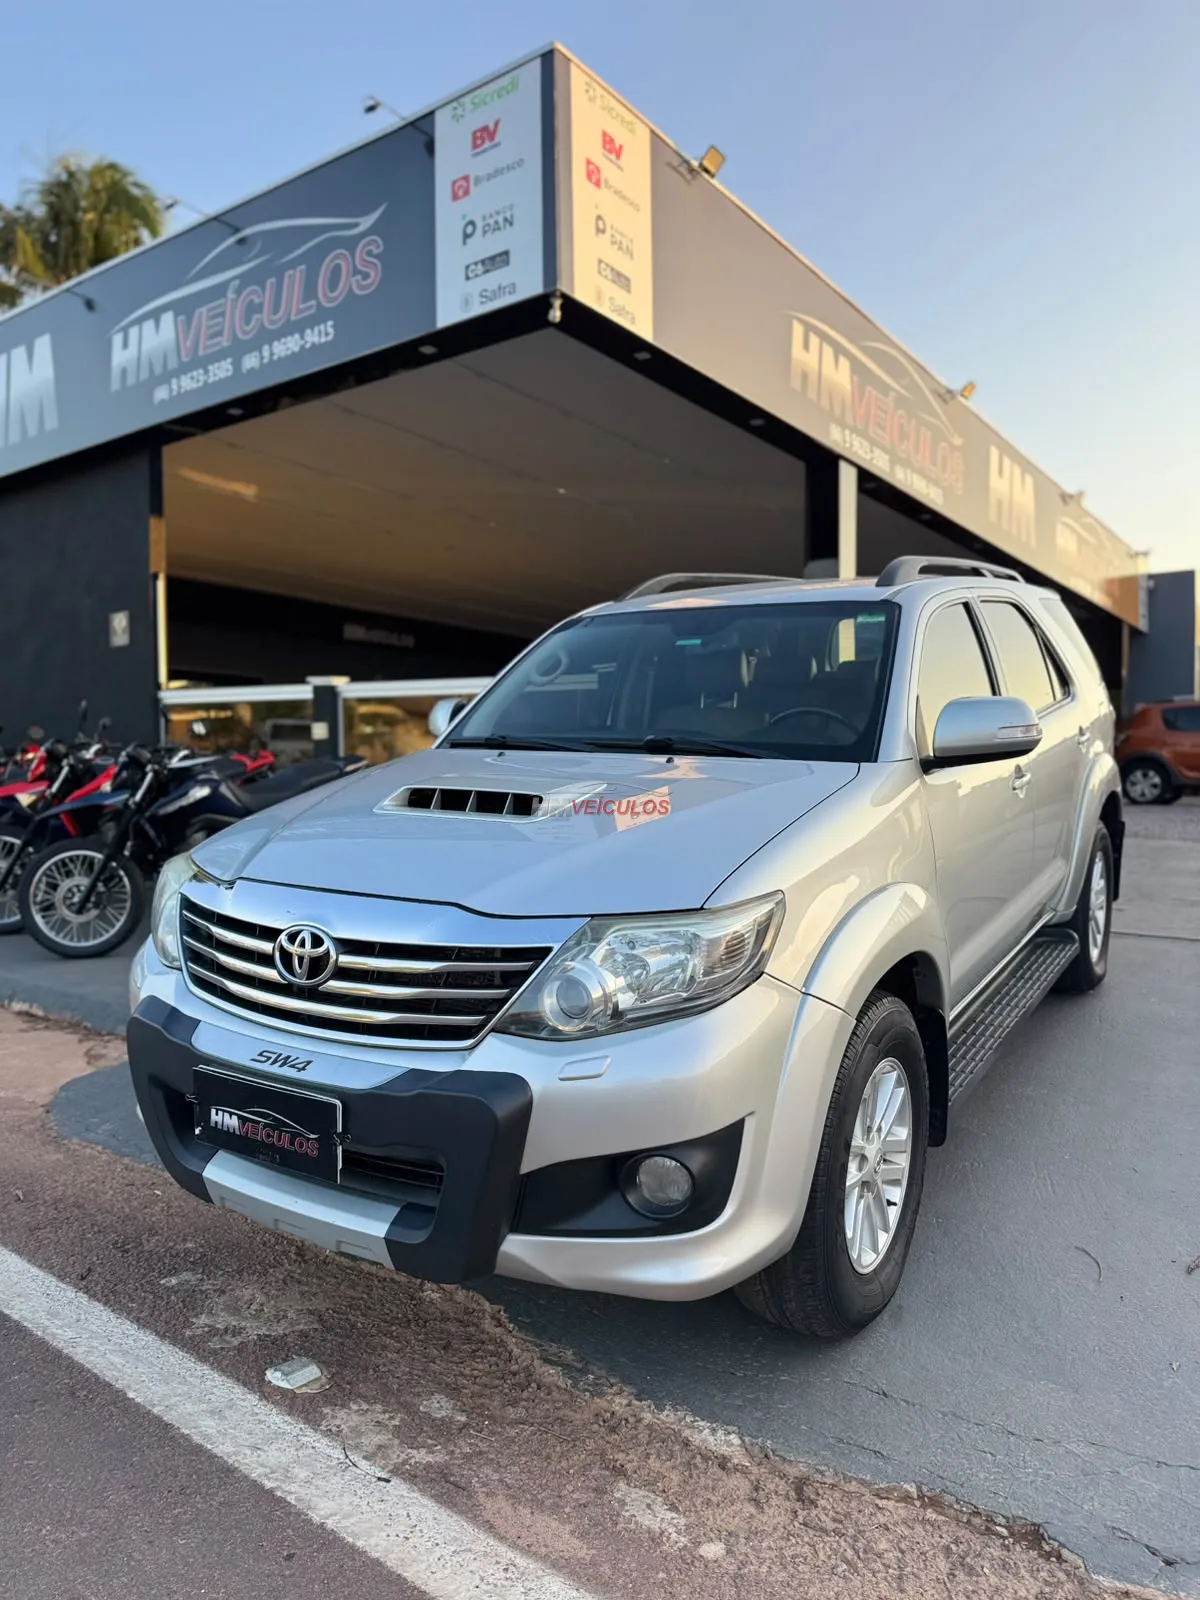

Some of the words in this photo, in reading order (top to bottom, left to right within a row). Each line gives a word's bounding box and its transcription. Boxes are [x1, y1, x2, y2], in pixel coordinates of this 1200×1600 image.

[469, 77, 520, 112] Sicredi
[471, 118, 501, 151] BV
[602, 128, 624, 161] BV
[473, 158, 525, 187] Bradesco
[482, 214, 514, 238] PAN
[478, 281, 516, 306] Safra
[988, 444, 1036, 548] HM
[249, 1050, 314, 1073] SW4
